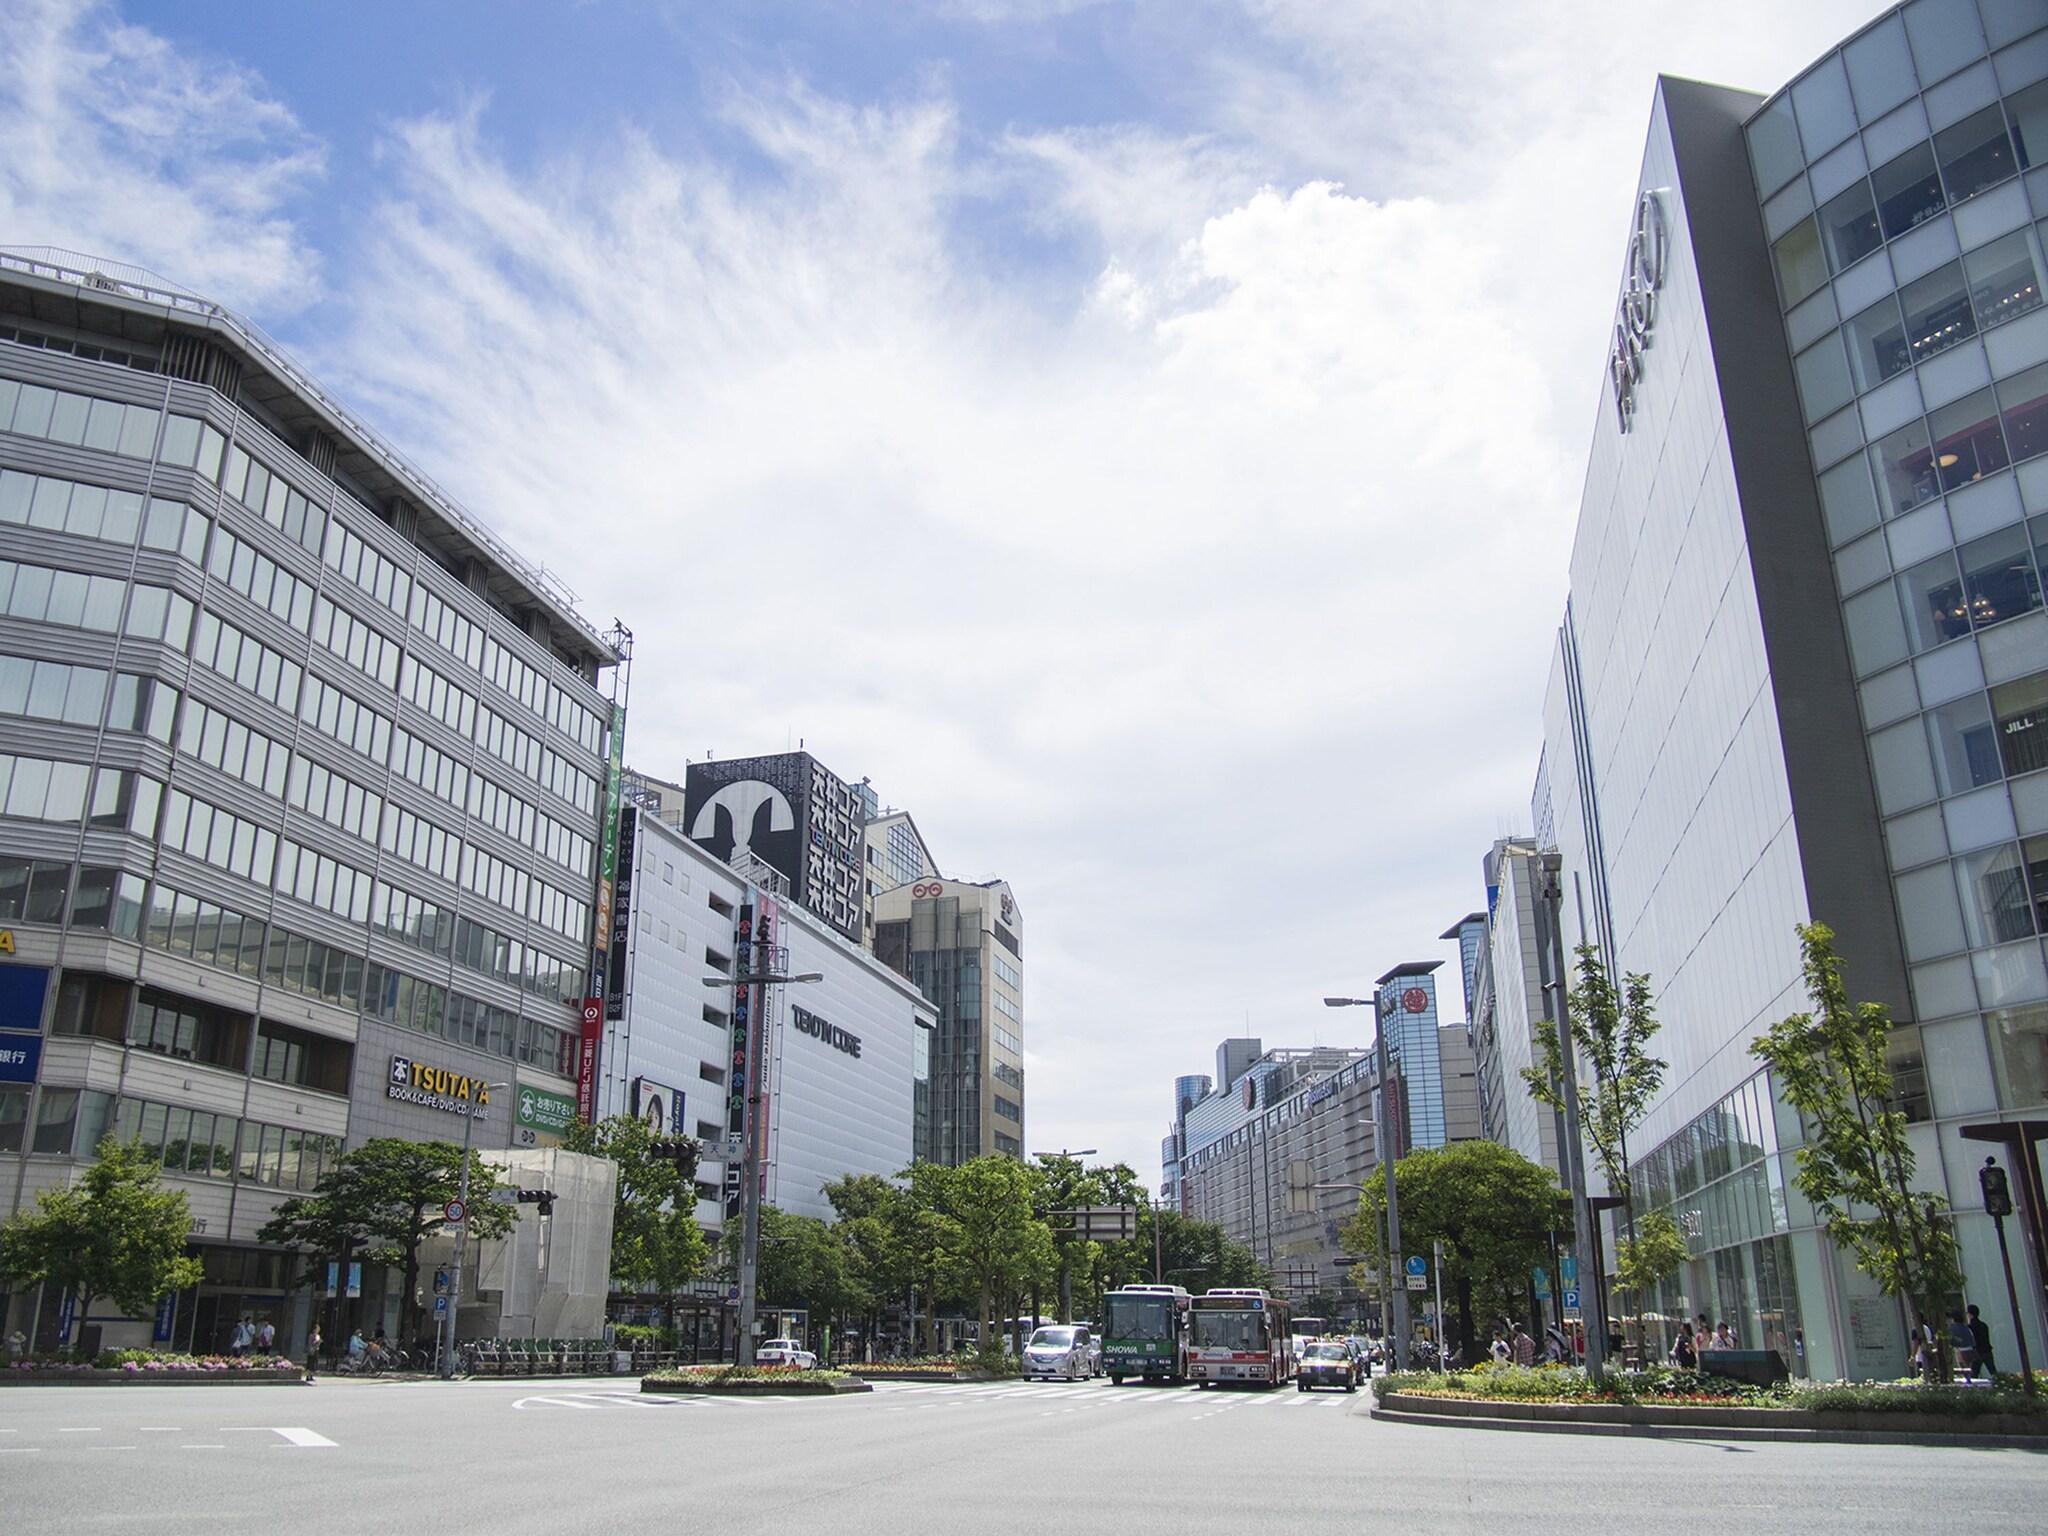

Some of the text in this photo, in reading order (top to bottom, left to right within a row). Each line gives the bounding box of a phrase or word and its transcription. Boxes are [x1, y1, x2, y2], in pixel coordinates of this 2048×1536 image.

[2005, 717, 2034, 735] JILL
[609, 992, 623, 1002] B1F
[833, 1025, 862, 1060] CORE
[388, 1086, 490, 1121] BOOK&CAFE/DVD/CD/AME
[450, 1205, 461, 1217] 50
[1105, 1344, 1139, 1354] SHOWA
